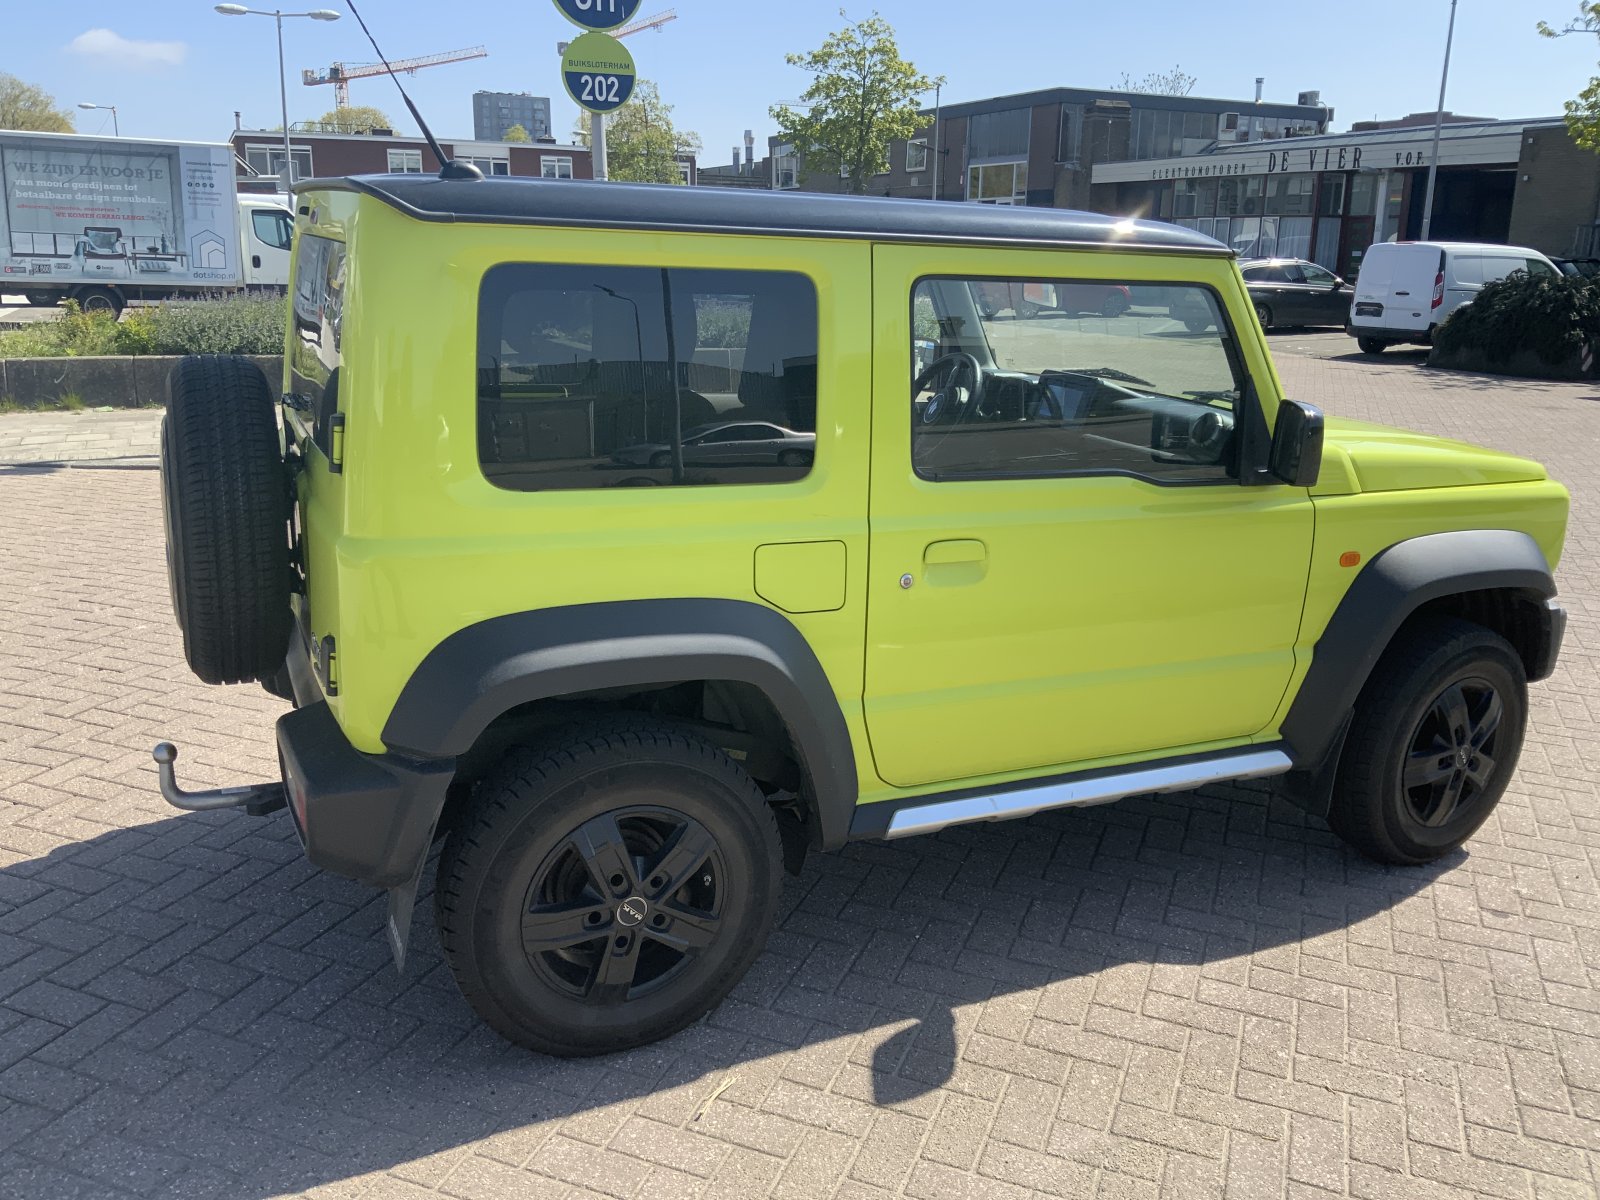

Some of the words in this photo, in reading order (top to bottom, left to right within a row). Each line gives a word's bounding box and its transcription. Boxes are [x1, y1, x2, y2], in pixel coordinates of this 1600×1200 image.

[568, 59, 630, 70] BUIKSLOTERHAM
[580, 75, 620, 103] 202
[1152, 163, 1247, 179] ELEKTROMOTOREN
[1268, 151, 1290, 172] DE
[1309, 147, 1362, 170] VIER
[1395, 151, 1425, 166] V.O.F.
[13, 162, 38, 173] WE
[41, 163, 74, 176] ZIJN
[79, 165, 98, 176] ER
[101, 166, 145, 178] VOOR
[148, 168, 164, 181] JE
[35, 180, 70, 188] mooie
[71, 181, 122, 191] gordijnen
[124, 183, 138, 191] tot
[15, 189, 72, 200] betaalbare
[74, 192, 110, 203] design
[193, 272, 236, 280] dotshop.nl
[622, 904, 643, 921] MAK
